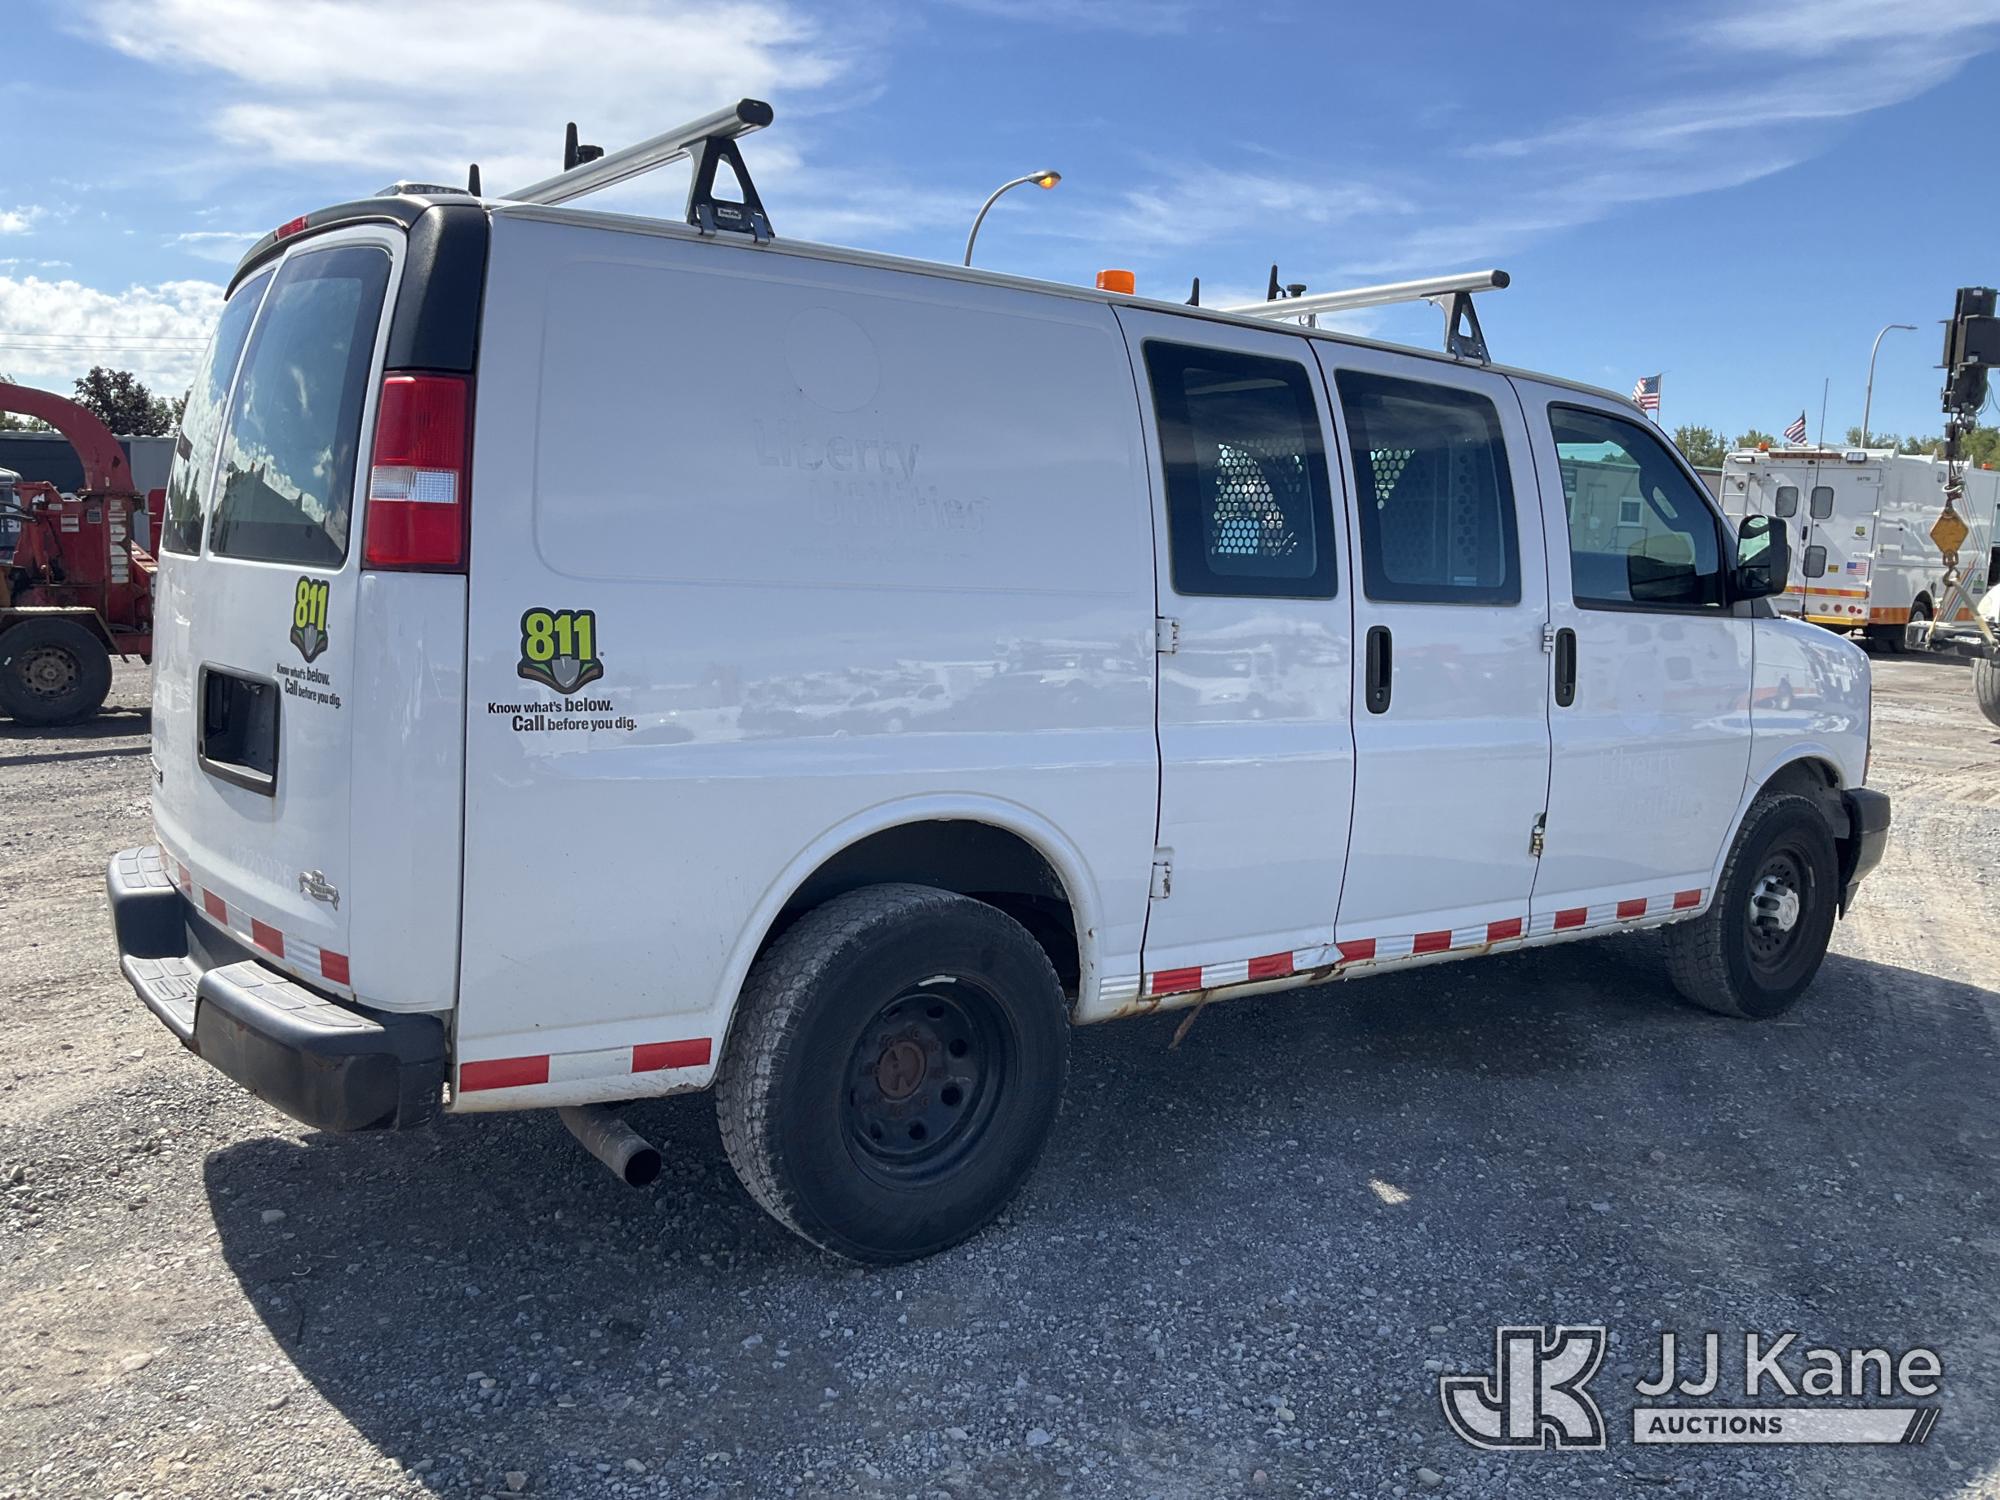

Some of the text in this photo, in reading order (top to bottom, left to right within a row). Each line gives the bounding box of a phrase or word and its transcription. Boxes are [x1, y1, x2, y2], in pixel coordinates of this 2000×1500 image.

[295, 580, 328, 631] 811
[526, 612, 592, 661] 811
[276, 663, 330, 686] Know what's below.
[284, 677, 342, 709] Call before you dig.
[488, 697, 613, 714] Know what's below.
[512, 714, 638, 732] Call before you dig.
